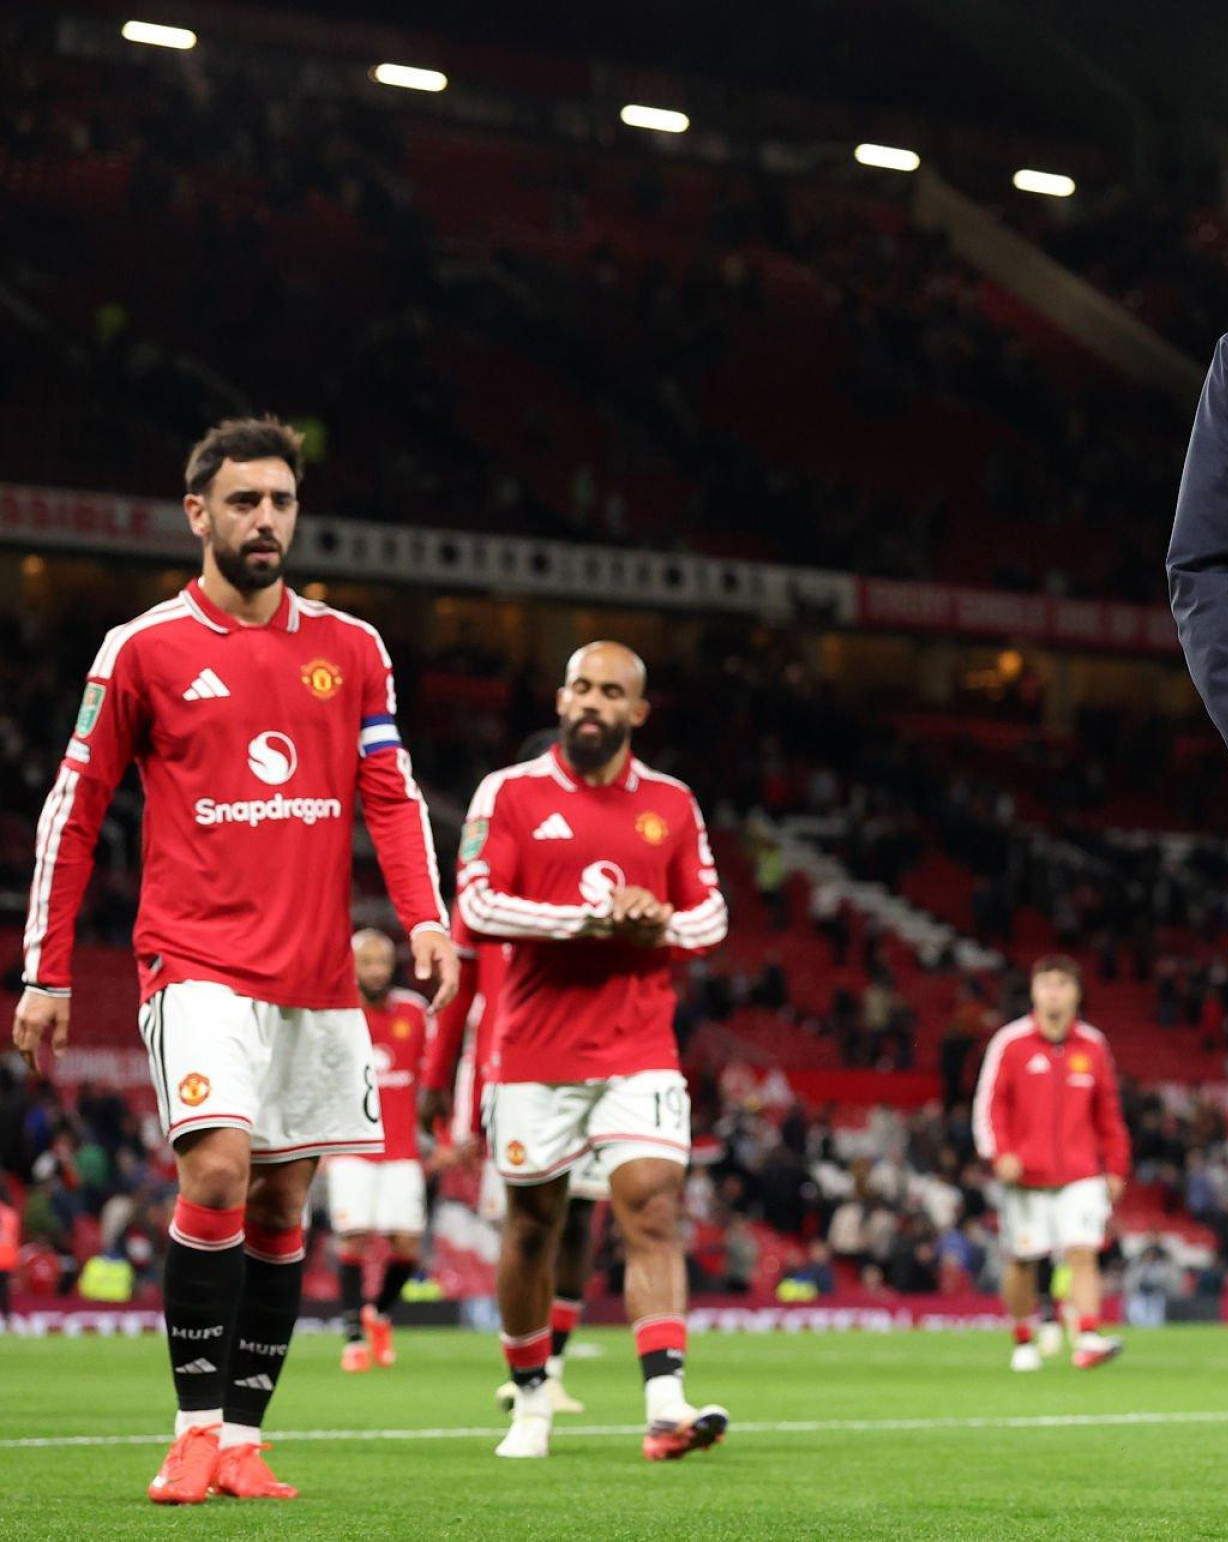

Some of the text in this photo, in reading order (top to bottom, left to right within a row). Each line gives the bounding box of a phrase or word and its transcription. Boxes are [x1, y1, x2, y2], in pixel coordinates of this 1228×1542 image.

[195, 793, 341, 827] Snapdragon
[171, 1325, 224, 1340] MUFC
[239, 1338, 289, 1357] MUFC
